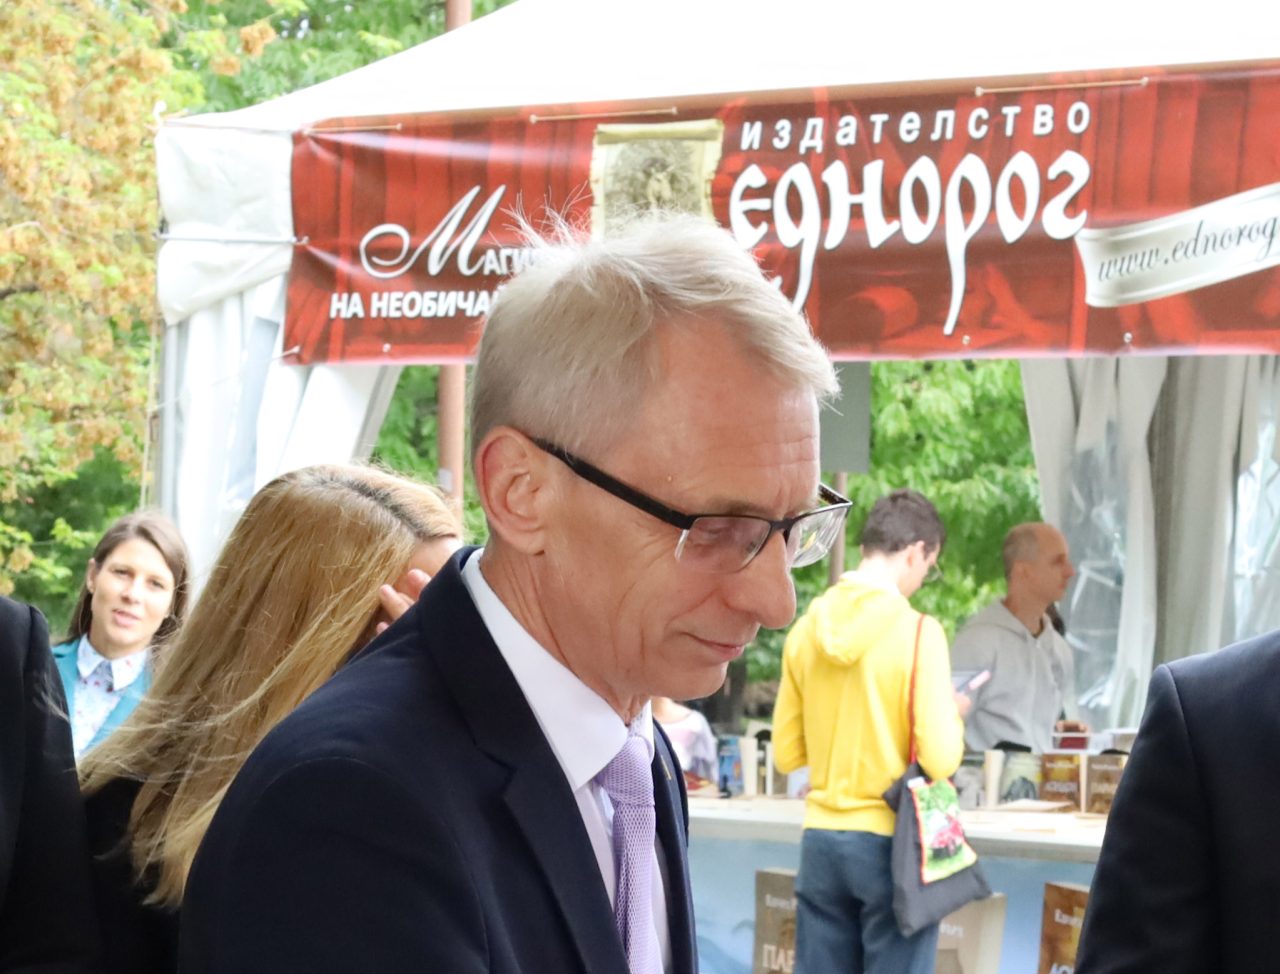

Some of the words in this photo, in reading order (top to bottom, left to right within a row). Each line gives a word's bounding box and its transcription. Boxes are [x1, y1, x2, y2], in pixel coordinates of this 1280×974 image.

[740, 100, 1091, 155] издателство
[330, 292, 365, 319] НА
[370, 290, 500, 318] НЕОБИЧА
